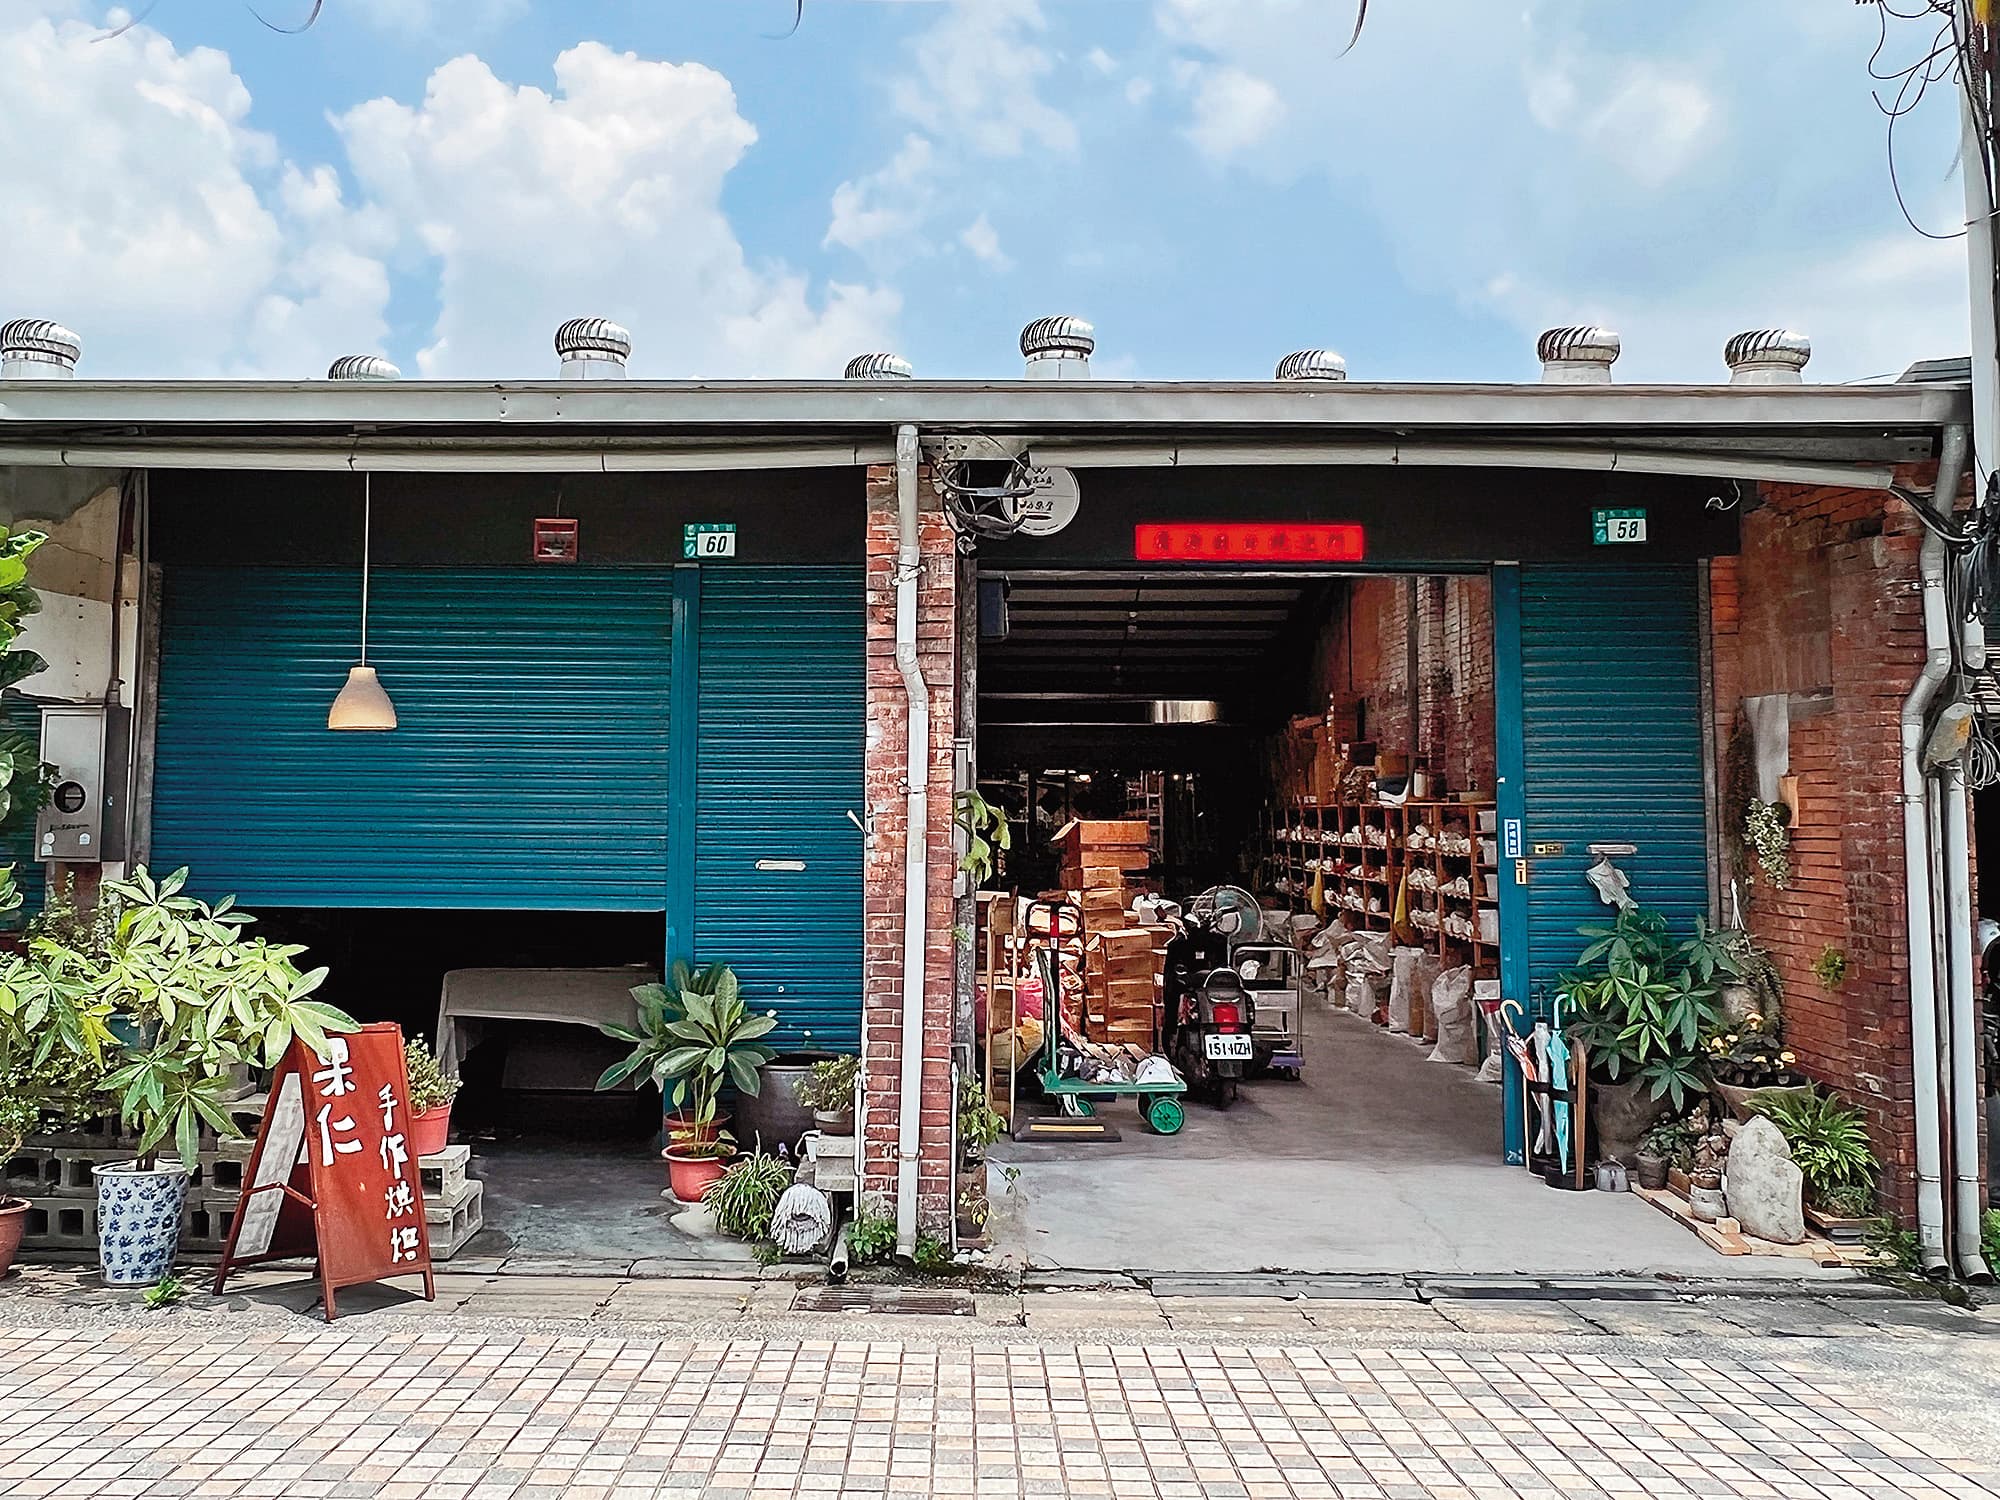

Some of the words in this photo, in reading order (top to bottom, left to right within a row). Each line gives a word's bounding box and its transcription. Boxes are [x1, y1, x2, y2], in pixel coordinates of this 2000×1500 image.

[706, 536, 727, 553] 60
[1617, 521, 1639, 539] 58
[313, 1037, 363, 1166] 果仁
[378, 1083, 419, 1263] 手作烘焙
